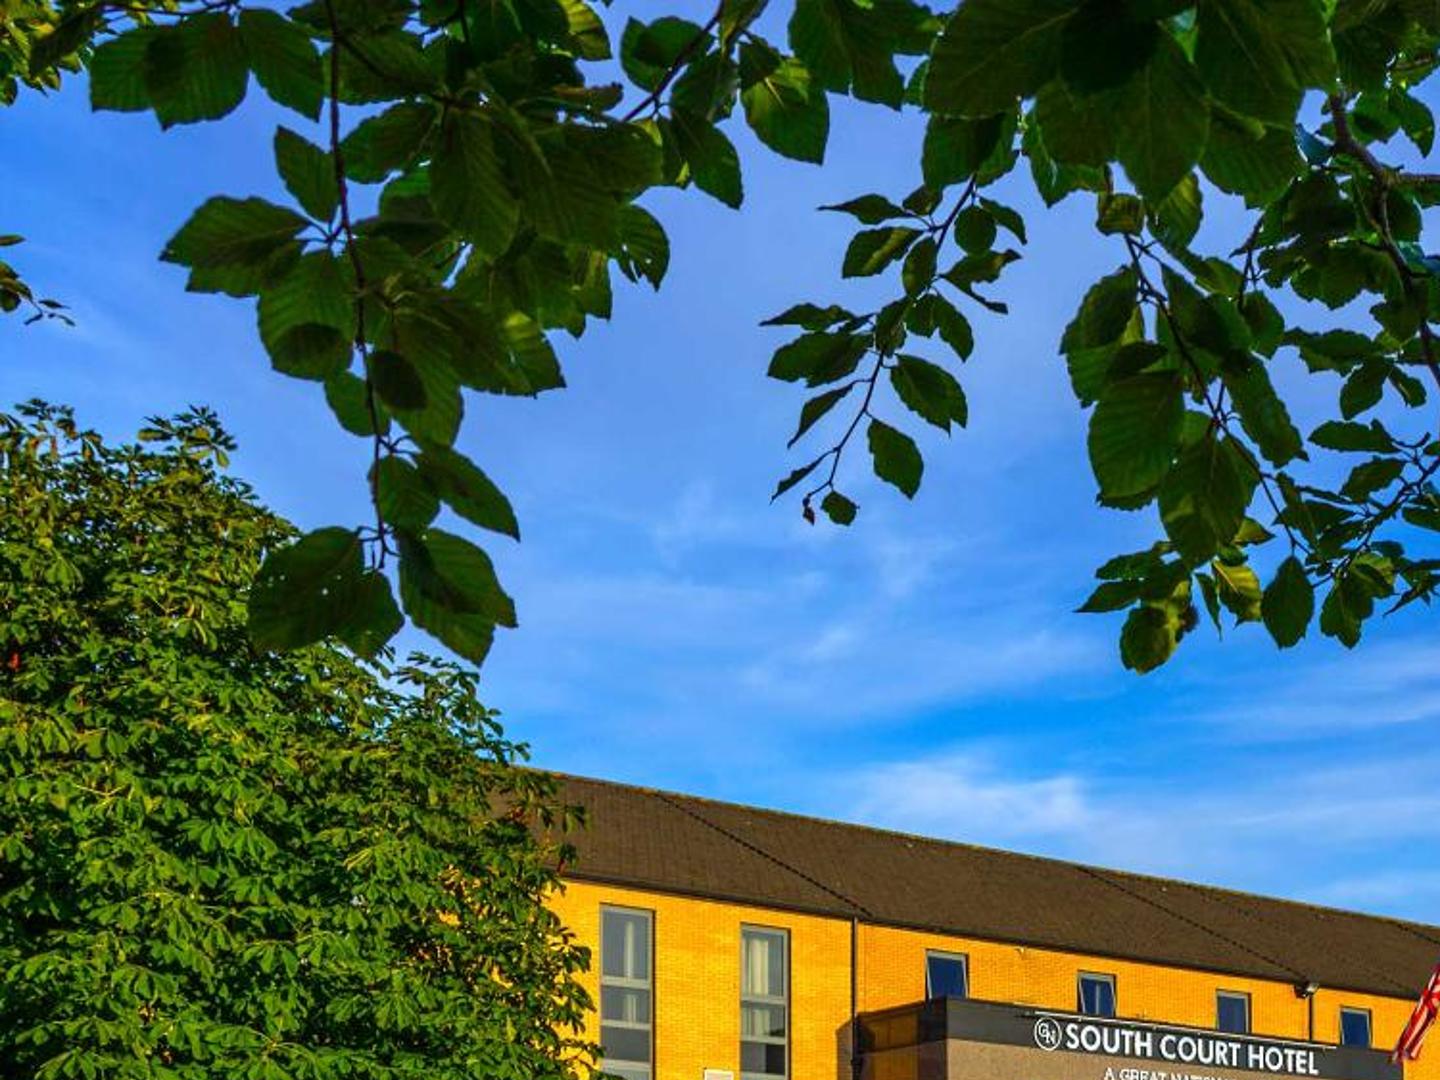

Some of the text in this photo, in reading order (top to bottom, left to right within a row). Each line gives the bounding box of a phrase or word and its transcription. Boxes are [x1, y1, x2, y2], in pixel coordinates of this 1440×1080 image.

[1065, 1022, 1320, 1075] SOUTH COURT HOTEL
